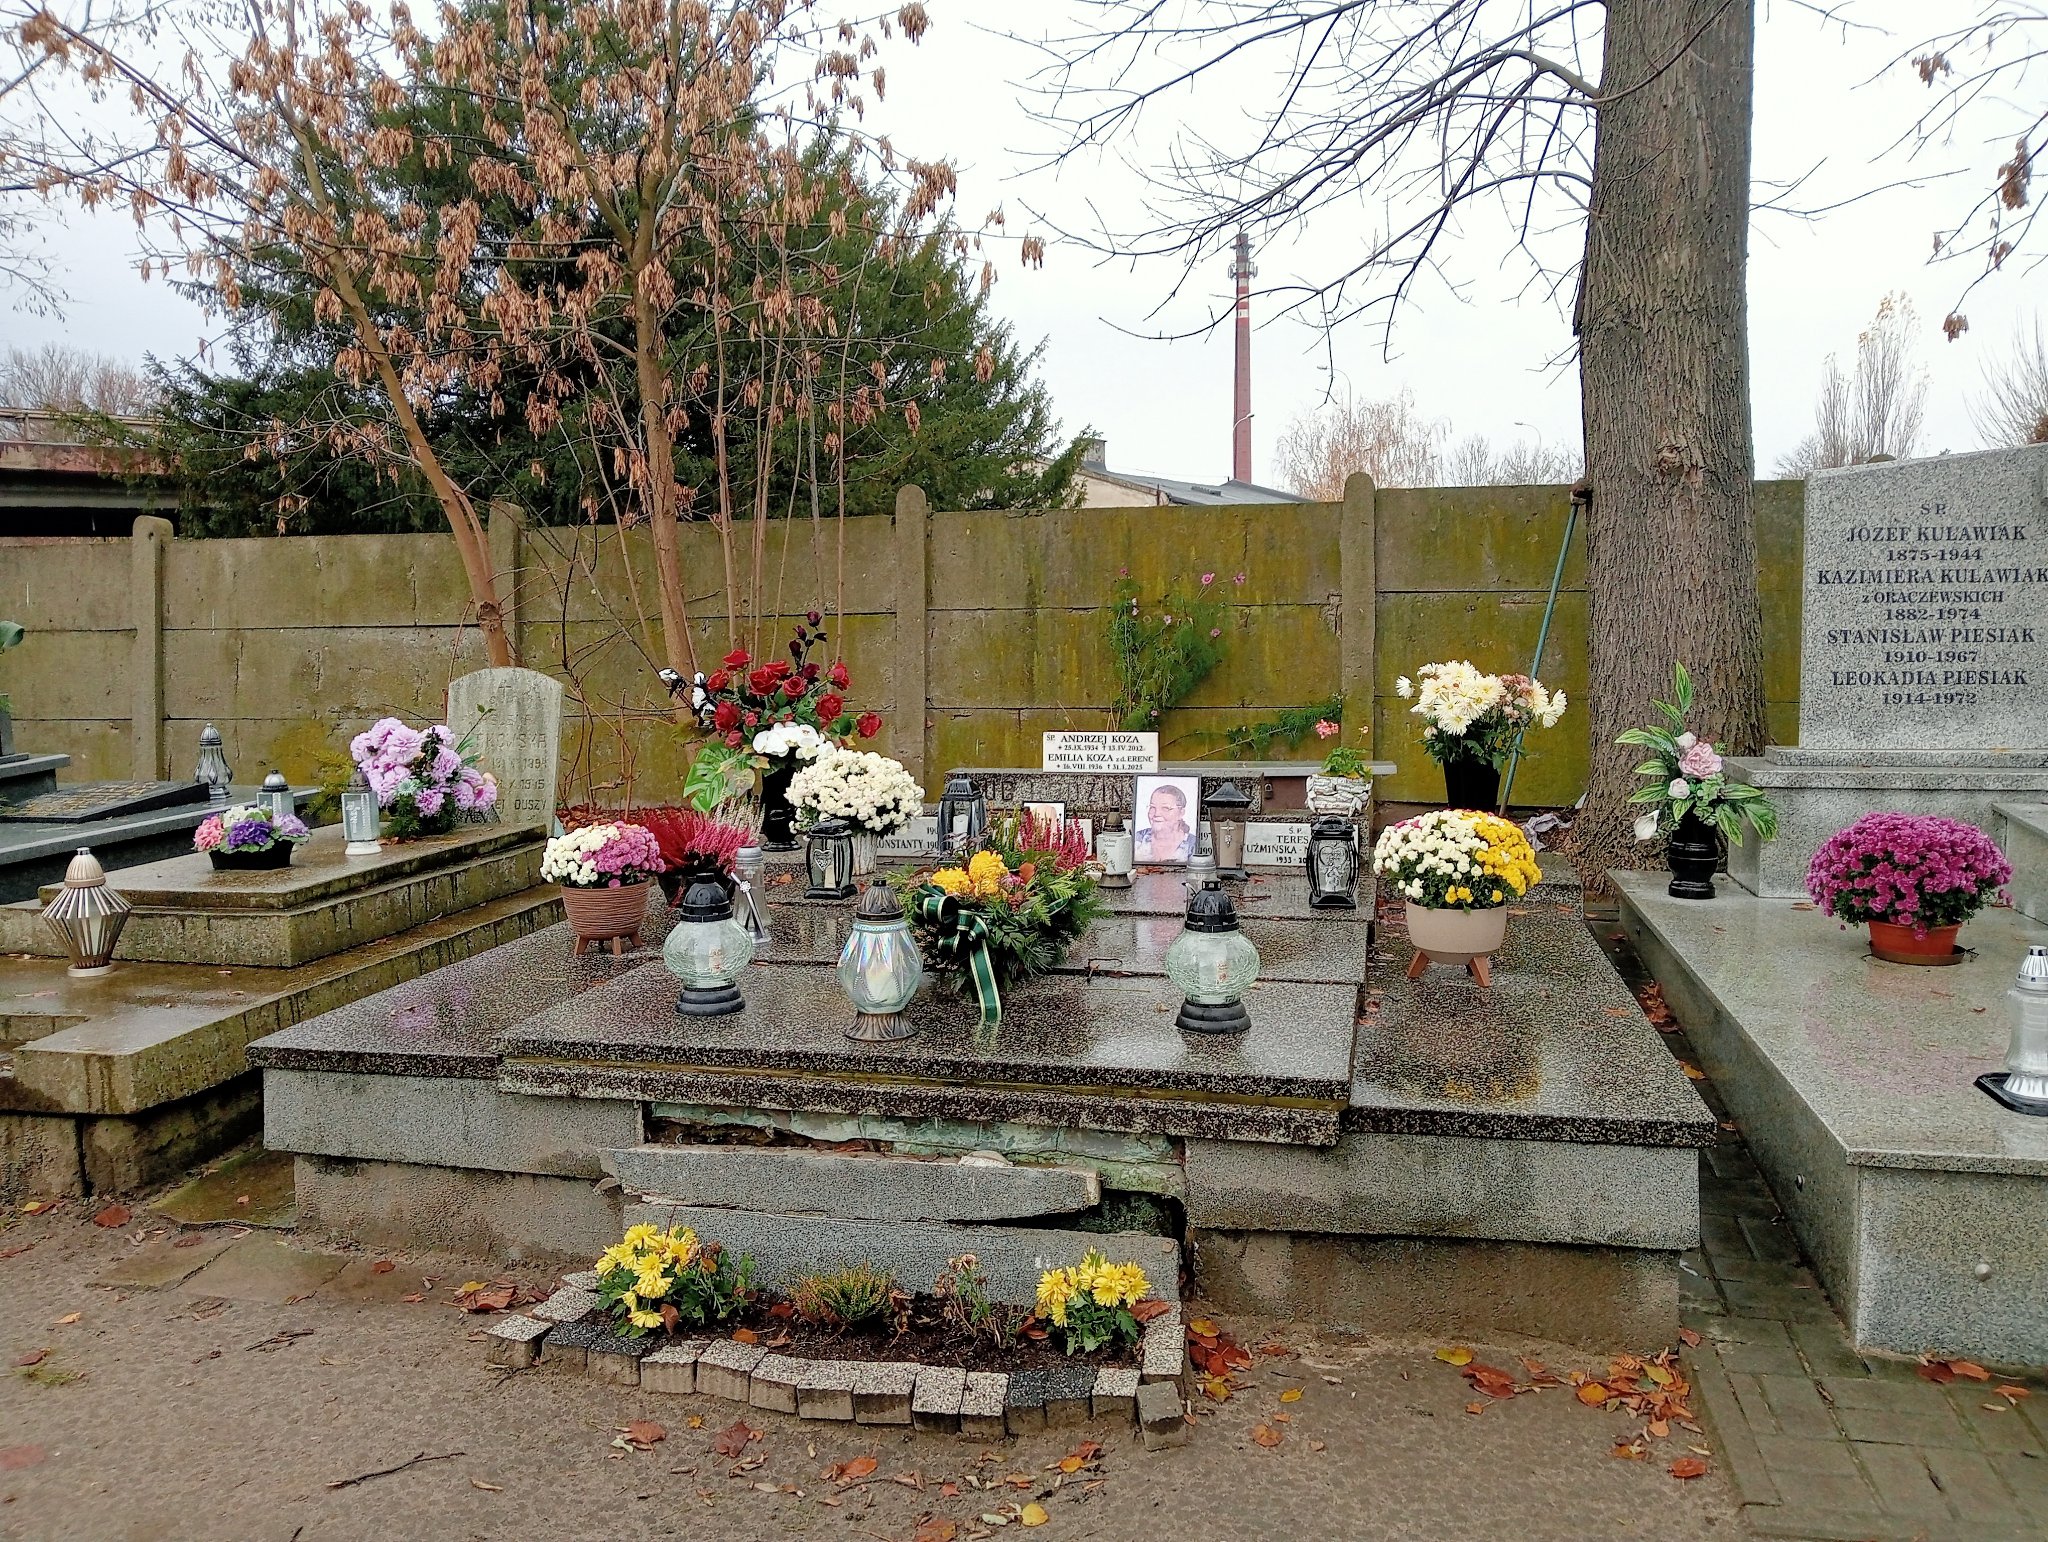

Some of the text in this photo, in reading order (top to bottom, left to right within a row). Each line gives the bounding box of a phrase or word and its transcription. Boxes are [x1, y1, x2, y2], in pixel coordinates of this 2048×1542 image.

[1887, 549, 1983, 562] 1875-1944
[1817, 569, 1932, 584] KAZIMIERA
[1885, 608, 1981, 620] 1882-1974
[1951, 628, 2036, 643] PIESIAK
[1884, 651, 1978, 663] 1910-1967
[1832, 670, 2028, 685] LEOKADIA PIESIAK
[1883, 692, 1977, 705] 1914-1972
[1061, 735, 1107, 745] ANDRZEJ
[1112, 735, 1139, 744] KOZA
[1048, 754, 1083, 762] EMILIA
[1086, 754, 1113, 762] KOZA
[1276, 835, 1309, 844] TERES
[1246, 843, 1297, 854] UŹMIŃSKA
